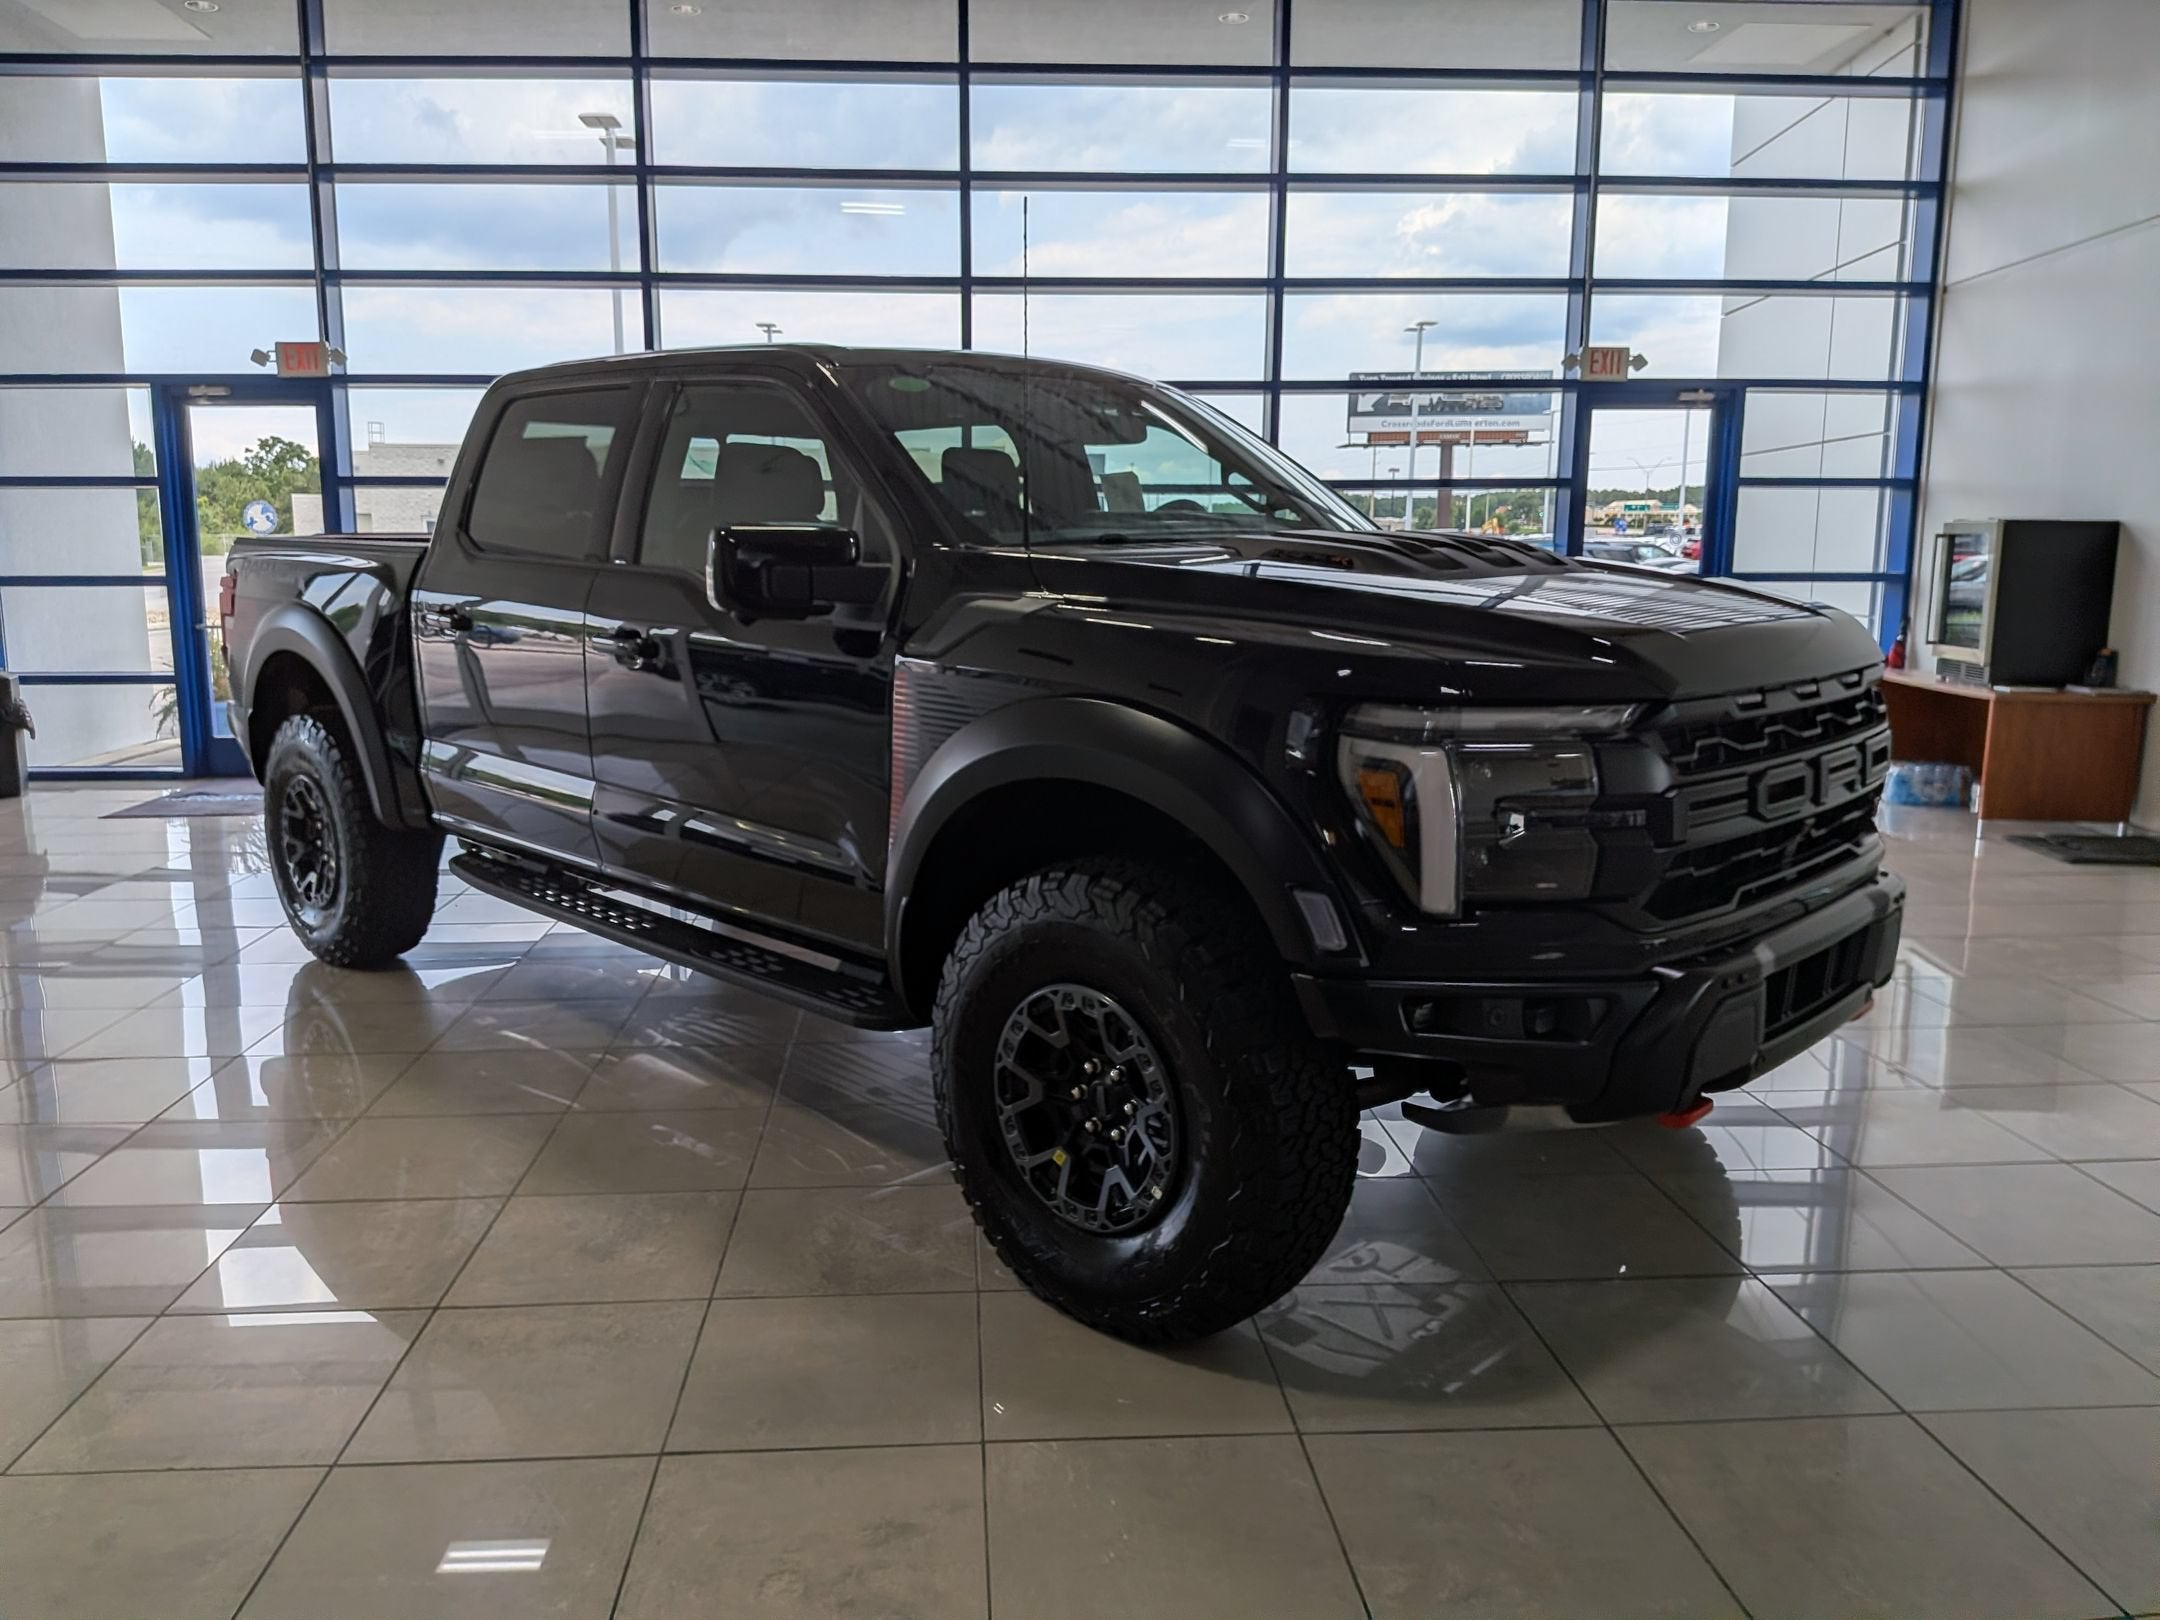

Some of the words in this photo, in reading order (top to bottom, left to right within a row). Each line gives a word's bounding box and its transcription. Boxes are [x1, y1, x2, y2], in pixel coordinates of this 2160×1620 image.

[283, 344, 320, 371] EXIT
[1590, 350, 1623, 374] EXIT
[1672, 731, 1892, 843] FORD
